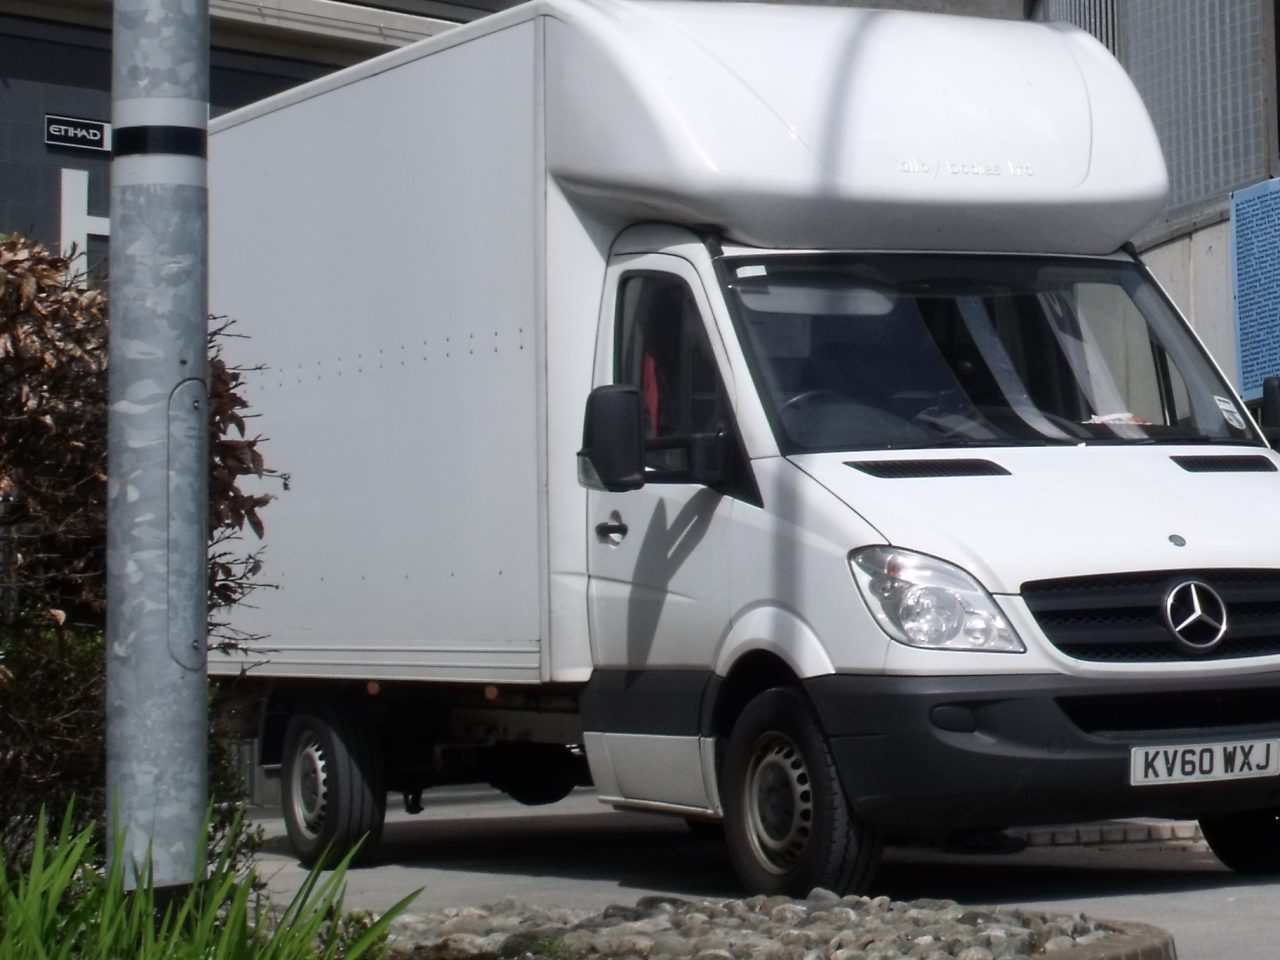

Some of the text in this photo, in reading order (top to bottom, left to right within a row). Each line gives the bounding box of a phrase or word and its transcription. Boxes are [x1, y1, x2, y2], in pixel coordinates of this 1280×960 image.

[49, 125, 101, 140] ETIHAD
[1143, 743, 1271, 779] KV60 WXJ
